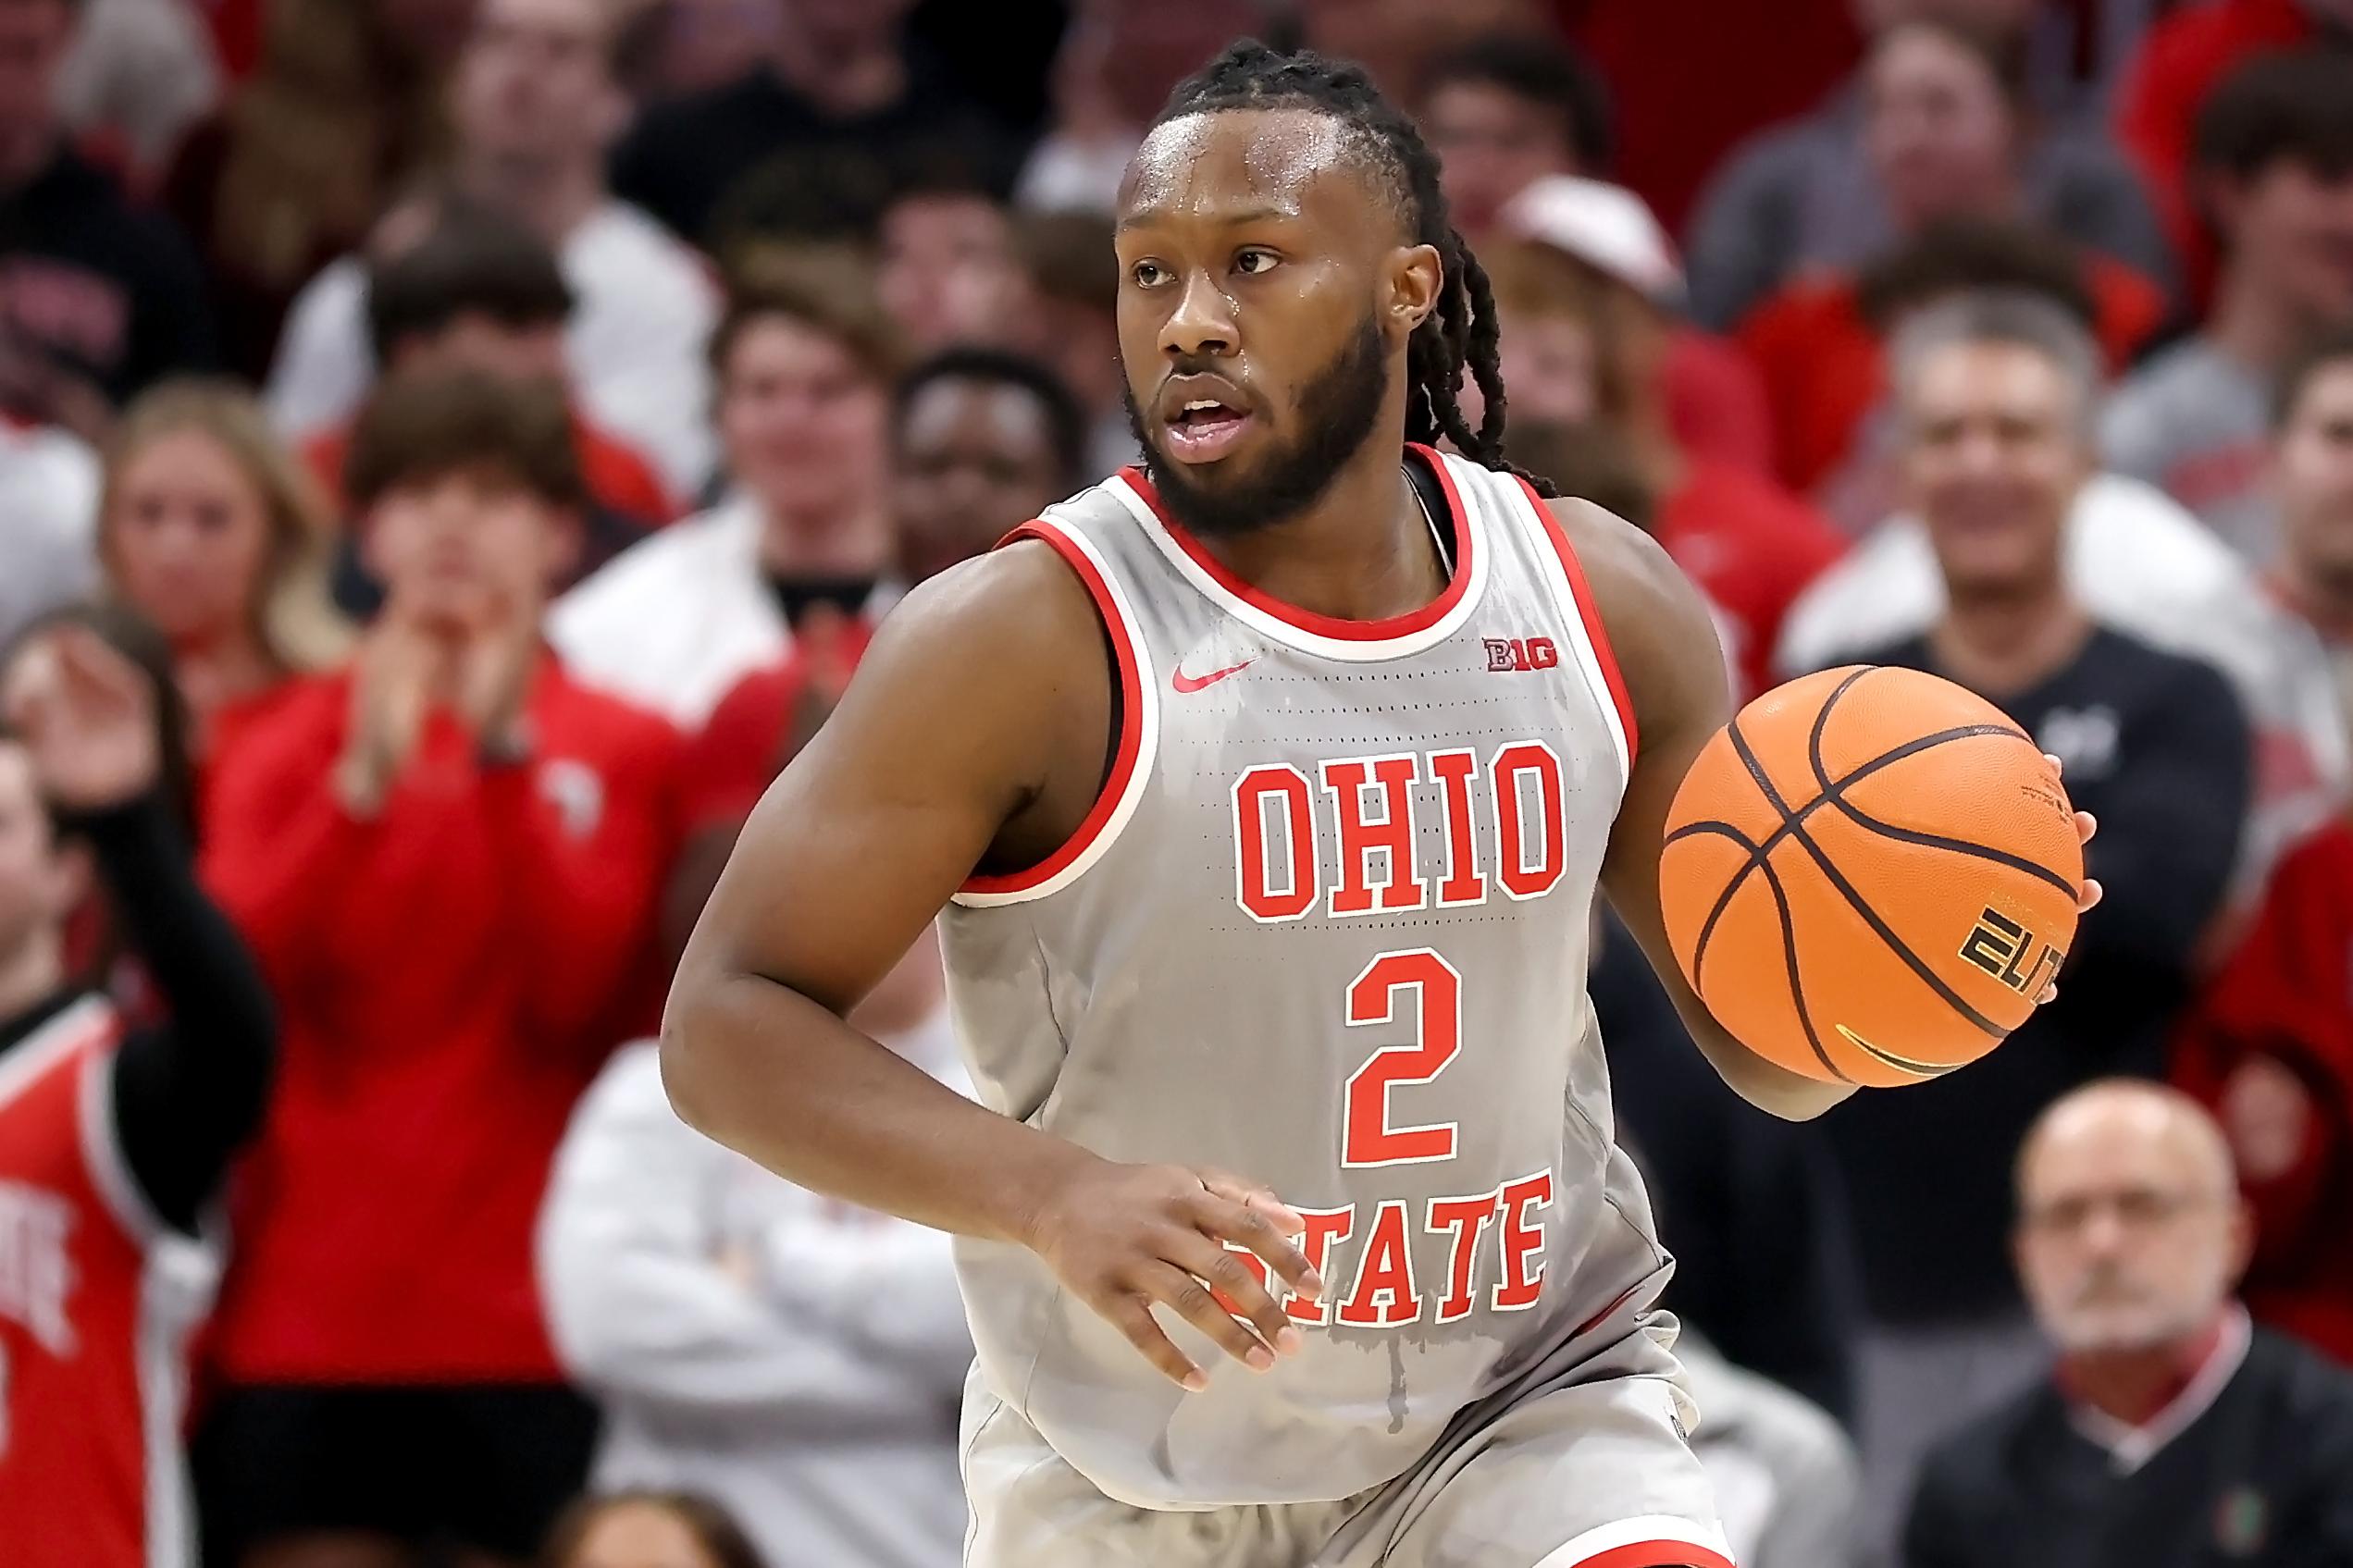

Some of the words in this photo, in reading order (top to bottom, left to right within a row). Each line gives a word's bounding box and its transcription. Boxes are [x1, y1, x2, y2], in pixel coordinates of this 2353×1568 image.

[1231, 739, 1567, 923] OHIO
[1957, 904, 2065, 1006] ELIT
[1341, 947, 1462, 1168] 2
